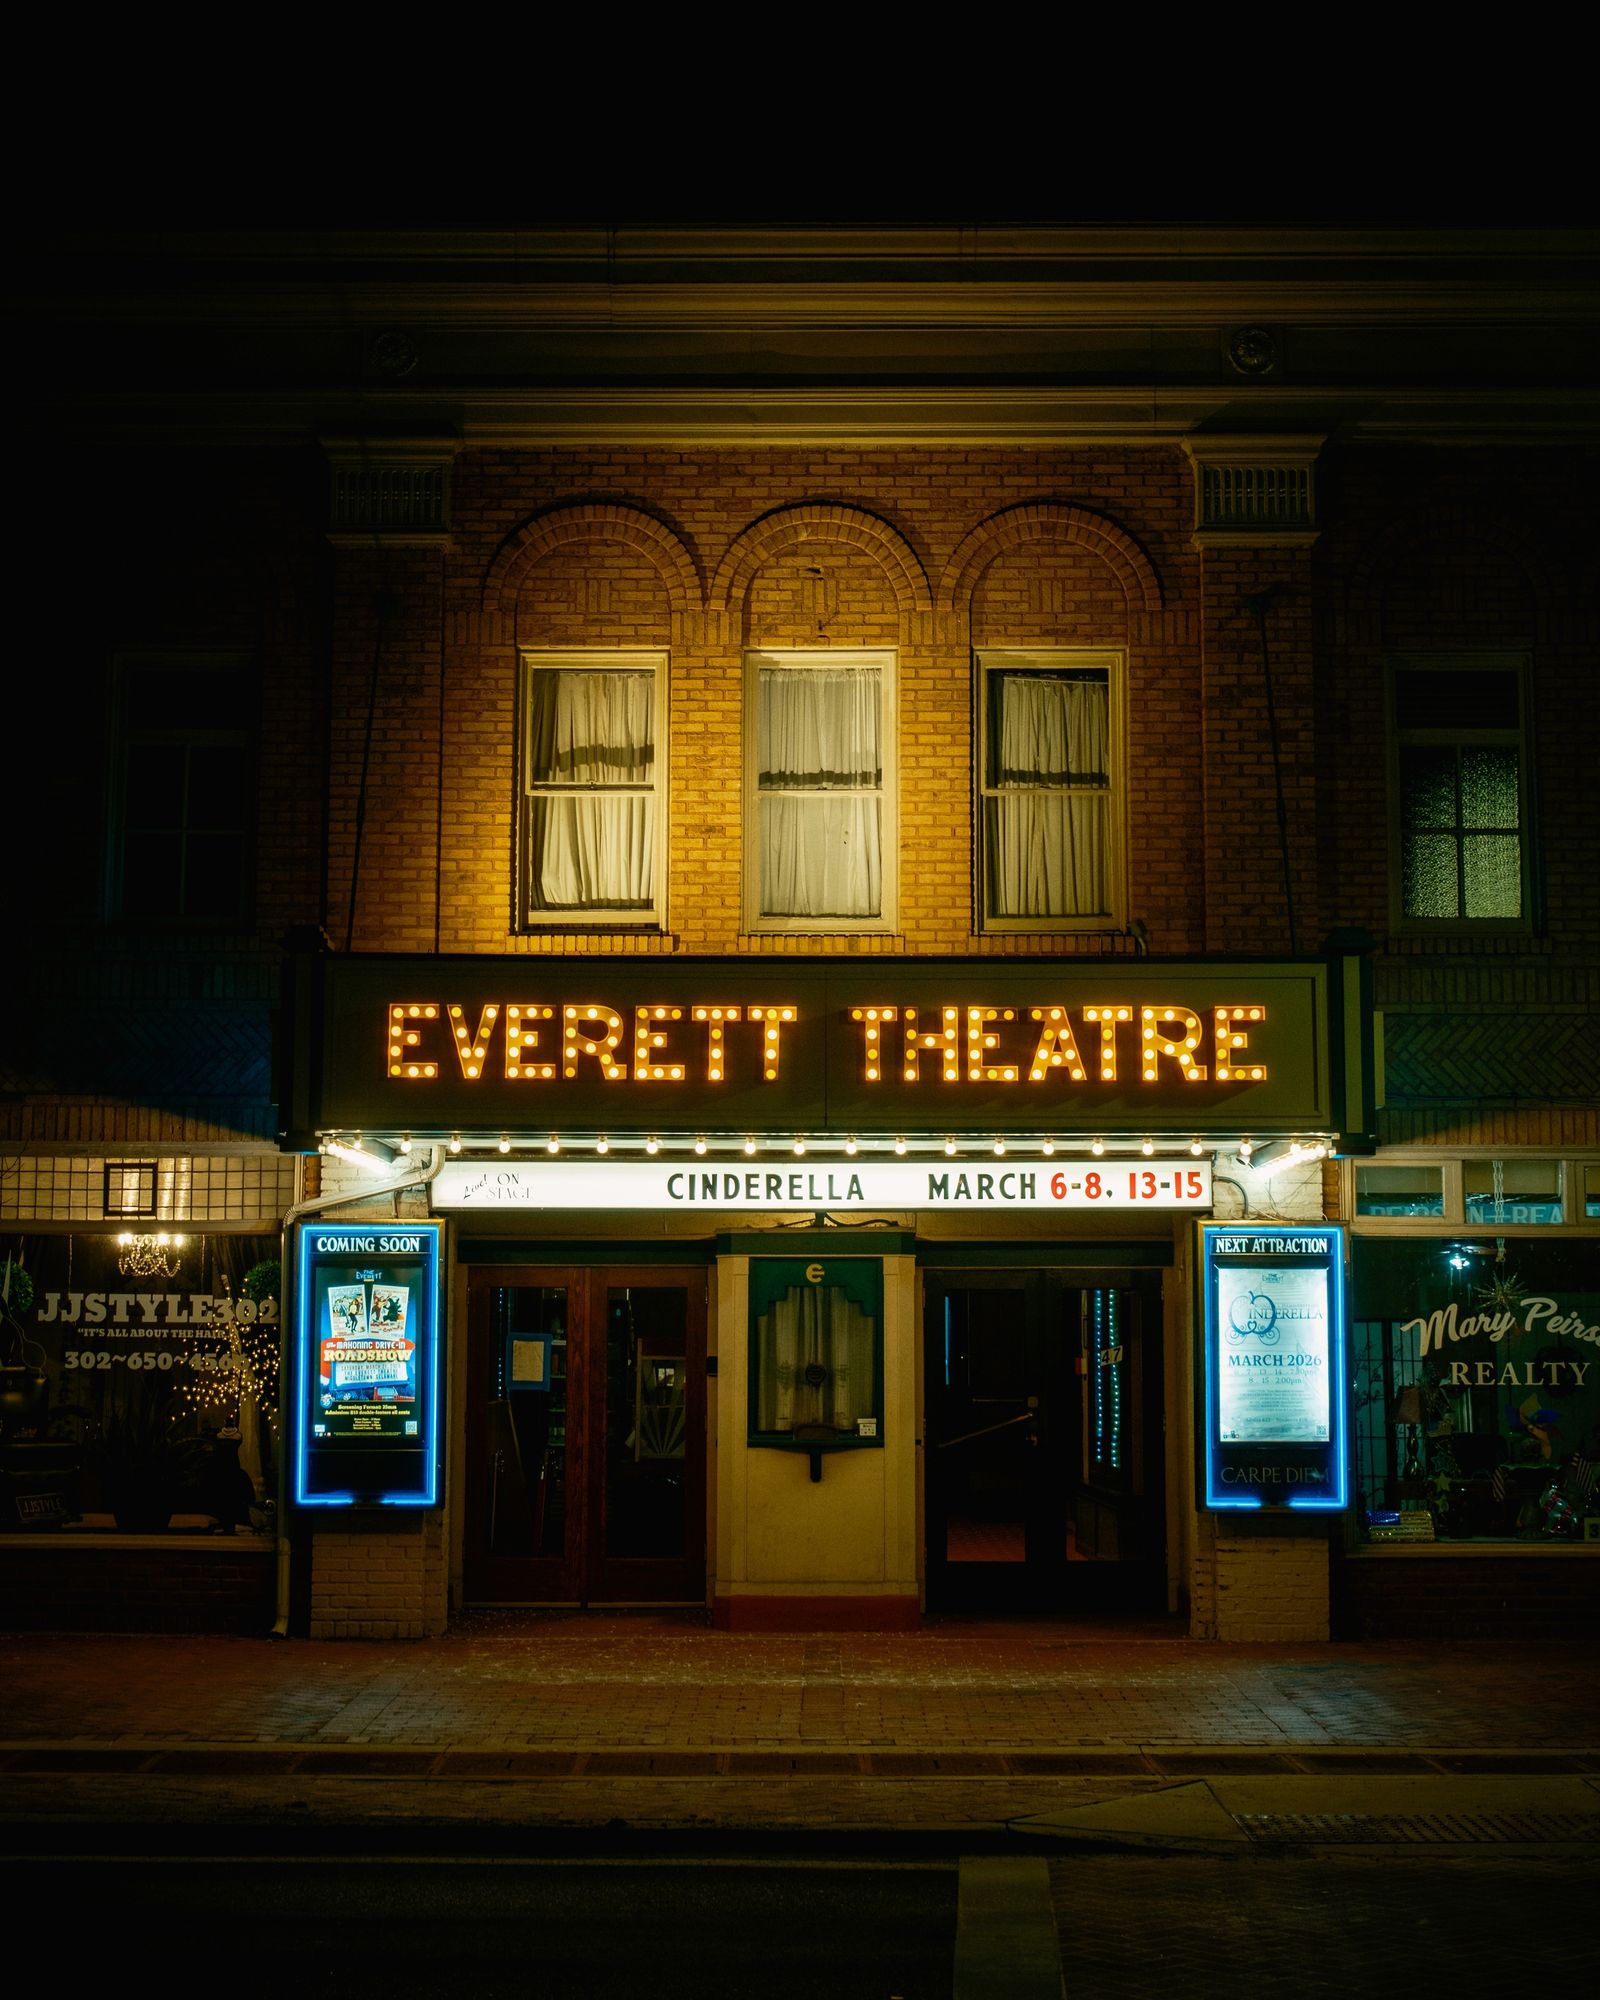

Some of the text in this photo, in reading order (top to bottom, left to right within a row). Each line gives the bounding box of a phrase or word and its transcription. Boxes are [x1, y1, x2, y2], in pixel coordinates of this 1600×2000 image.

[387, 1003, 1267, 1080] EVERETT THEATRE
[497, 1172, 519, 1185] ON
[667, 1173, 864, 1200] CINDERELLA
[928, 1173, 1036, 1200] MARCH
[1128, 1171, 1203, 1199] 13-15
[317, 1237, 420, 1252] COMING SOON
[1216, 1238, 1328, 1253] NEXT ATTRACTION
[37, 1292, 279, 1324] JJSTYLE302
[107, 1329, 128, 1338] ALL
[130, 1329, 169, 1339] ABOUT
[171, 1329, 194, 1339] THE
[1400, 1303, 1516, 1357] Mary
[323, 1349, 411, 1362] ROADSHOW
[1229, 1354, 1322, 1367] MARCH 2026
[1450, 1360, 1590, 1386] REALTY
[1220, 1466, 1282, 1483] CARPE
